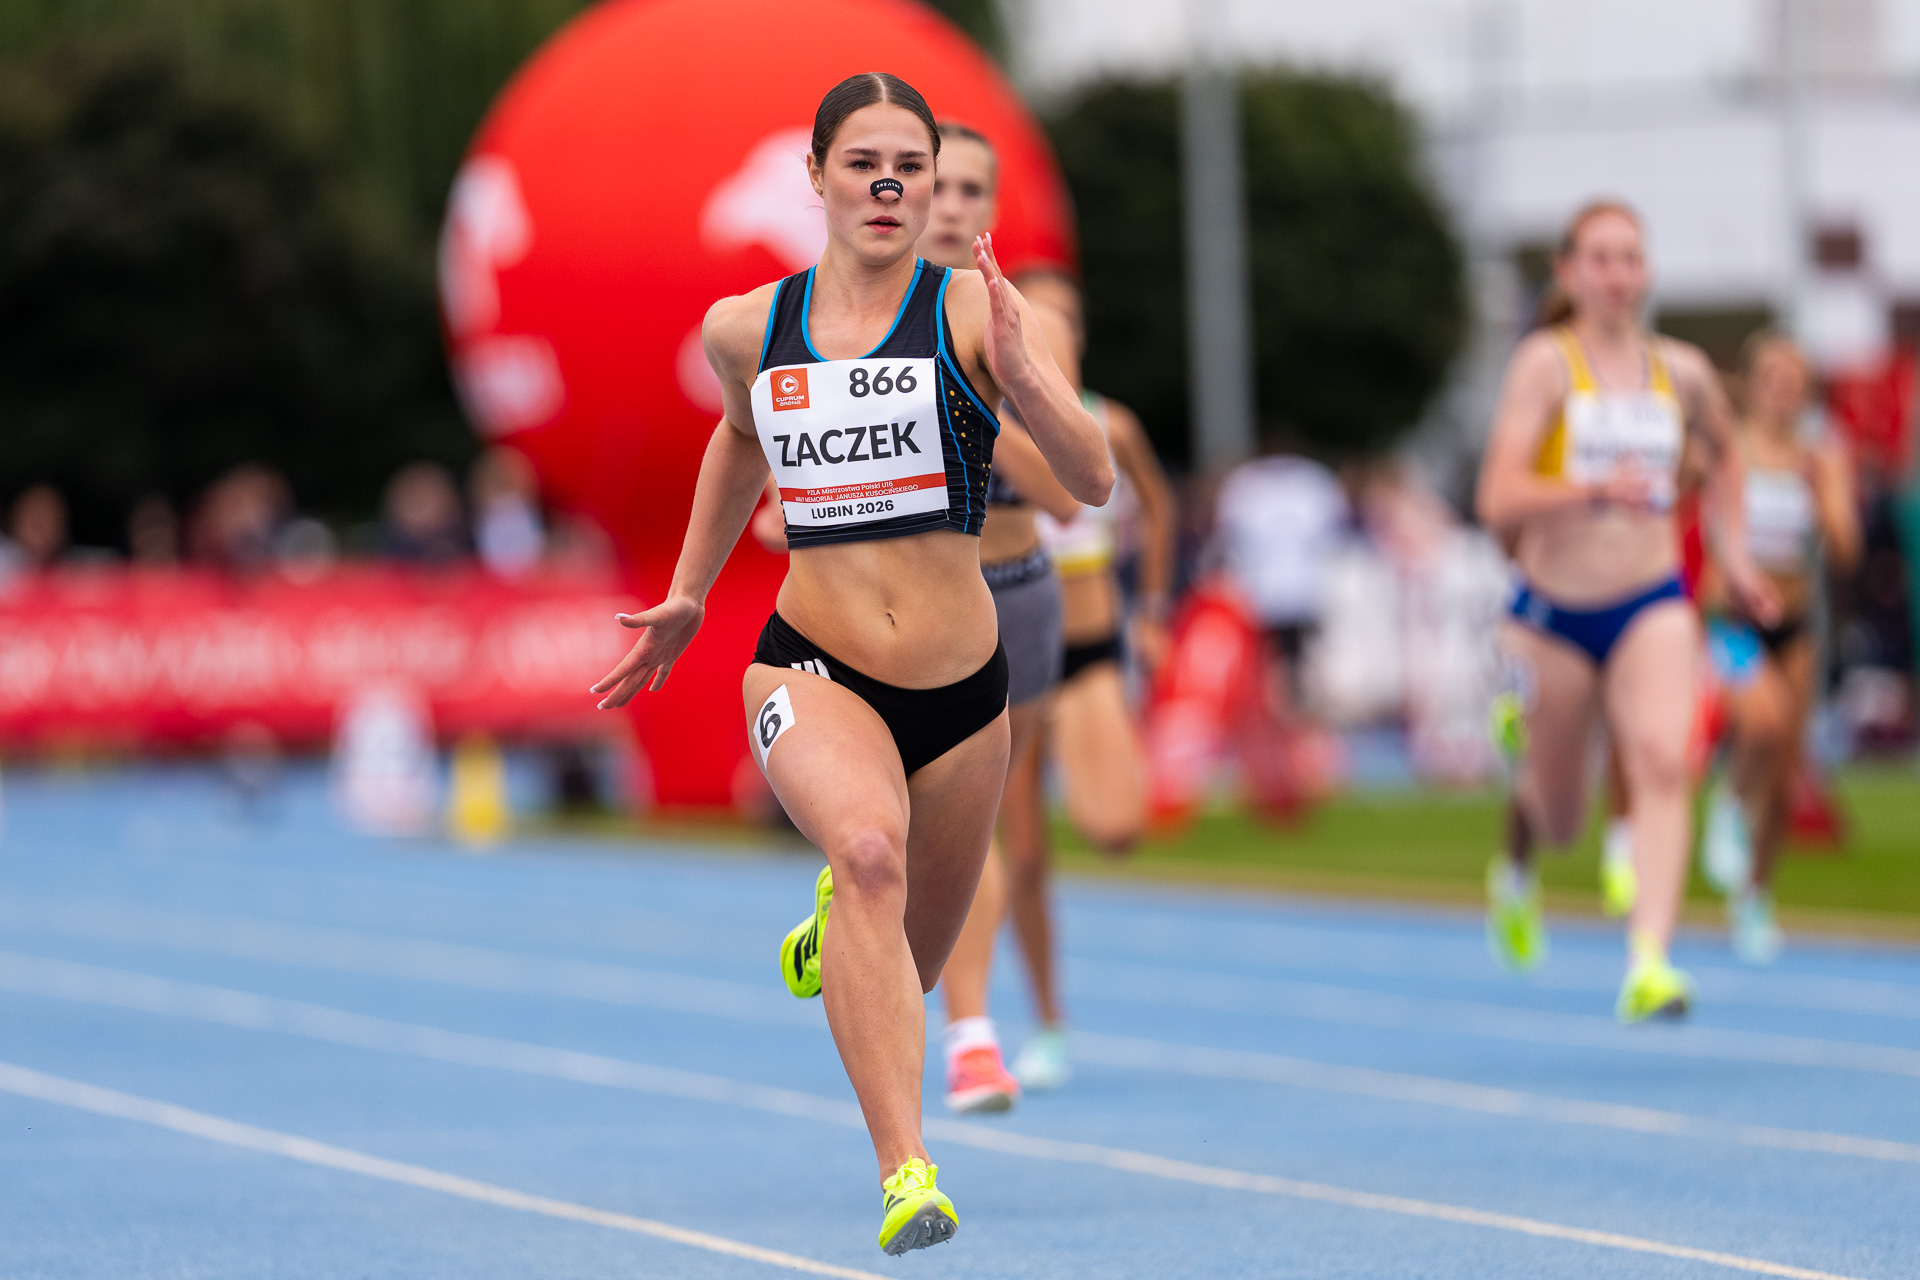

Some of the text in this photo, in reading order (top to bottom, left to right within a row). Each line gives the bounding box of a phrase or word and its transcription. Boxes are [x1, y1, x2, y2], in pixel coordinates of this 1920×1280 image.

[849, 366, 917, 398] 866
[773, 421, 921, 467] ZACZEK
[822, 485, 860, 494] Mistrzostwa
[861, 482, 880, 491] Polski
[835, 491, 864, 500] JANUSZA
[865, 484, 919, 497] KUSOCIŃSKIEGO
[811, 500, 894, 519] LUBIN 2026
[760, 701, 782, 749] 6
